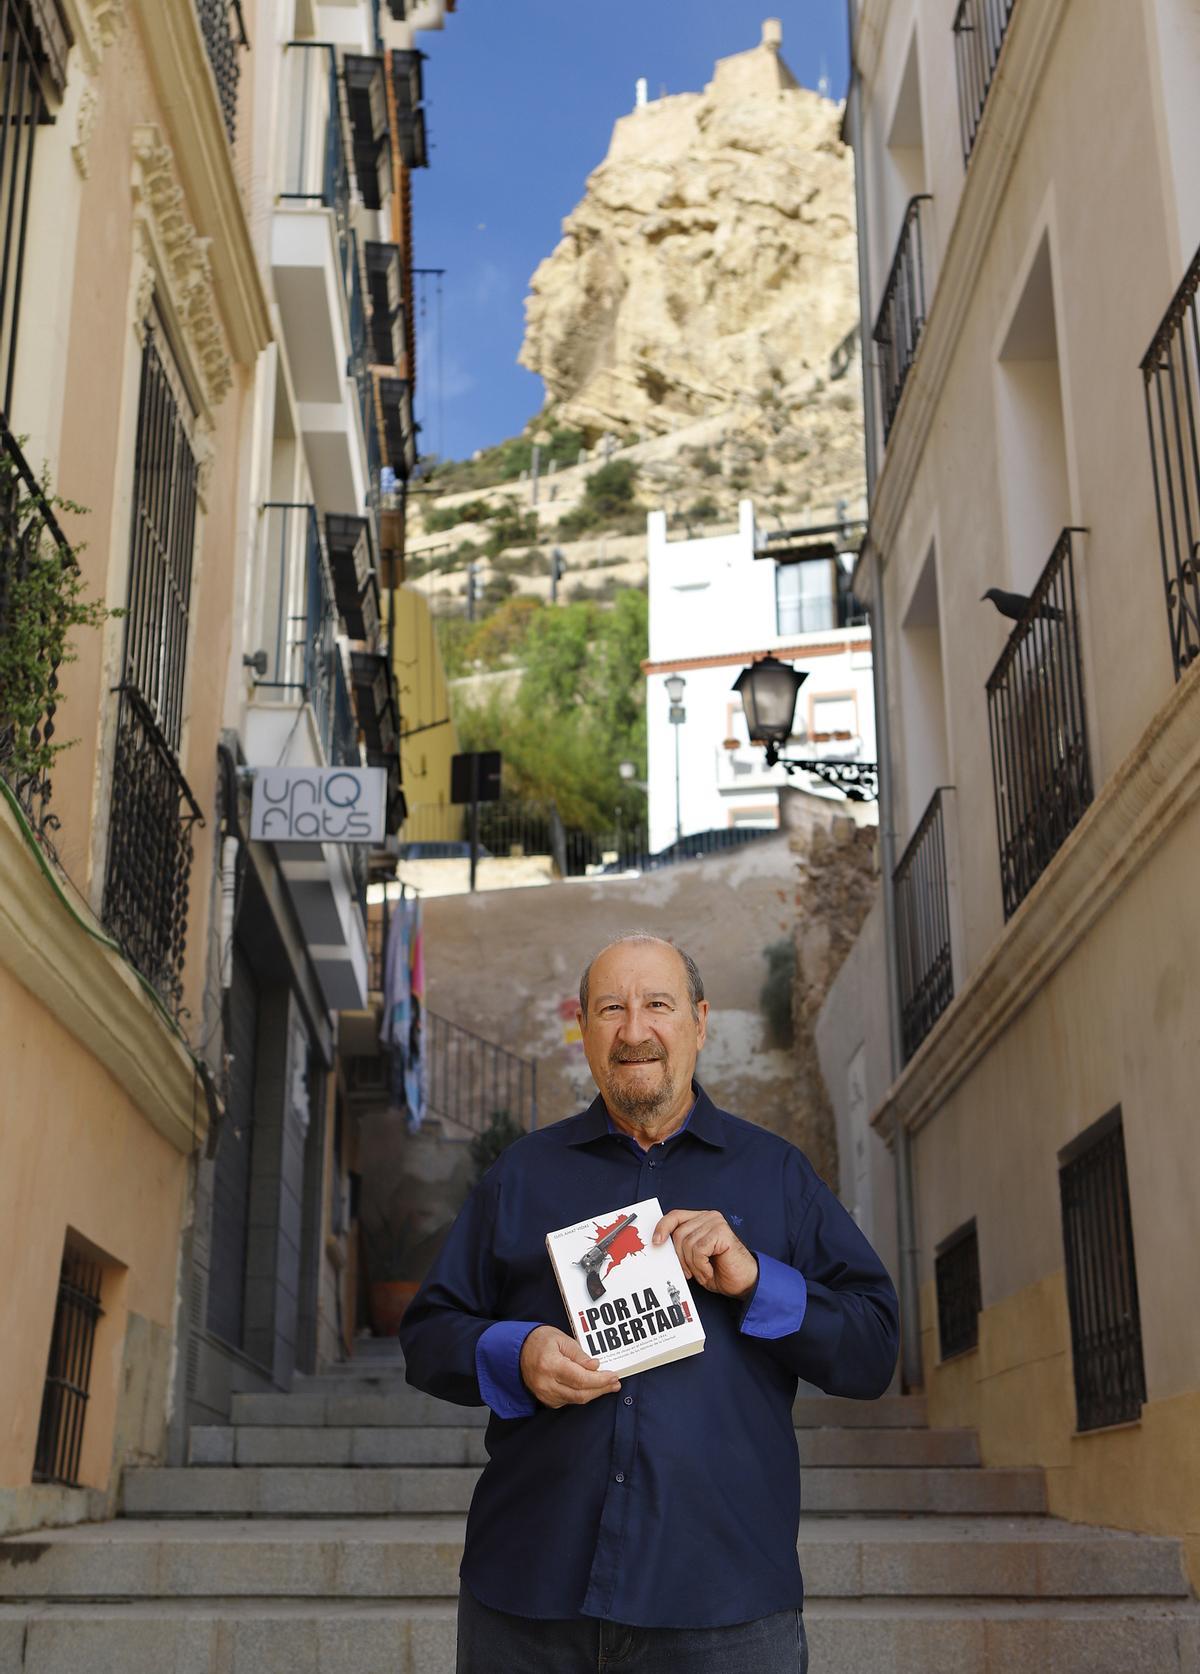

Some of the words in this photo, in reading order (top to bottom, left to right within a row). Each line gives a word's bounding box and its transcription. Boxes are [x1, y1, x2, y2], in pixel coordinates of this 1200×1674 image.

[578, 1297, 631, 1333] ¡POR
[631, 1287, 661, 1314] LA
[585, 1300, 694, 1356] LIBERTAD!
